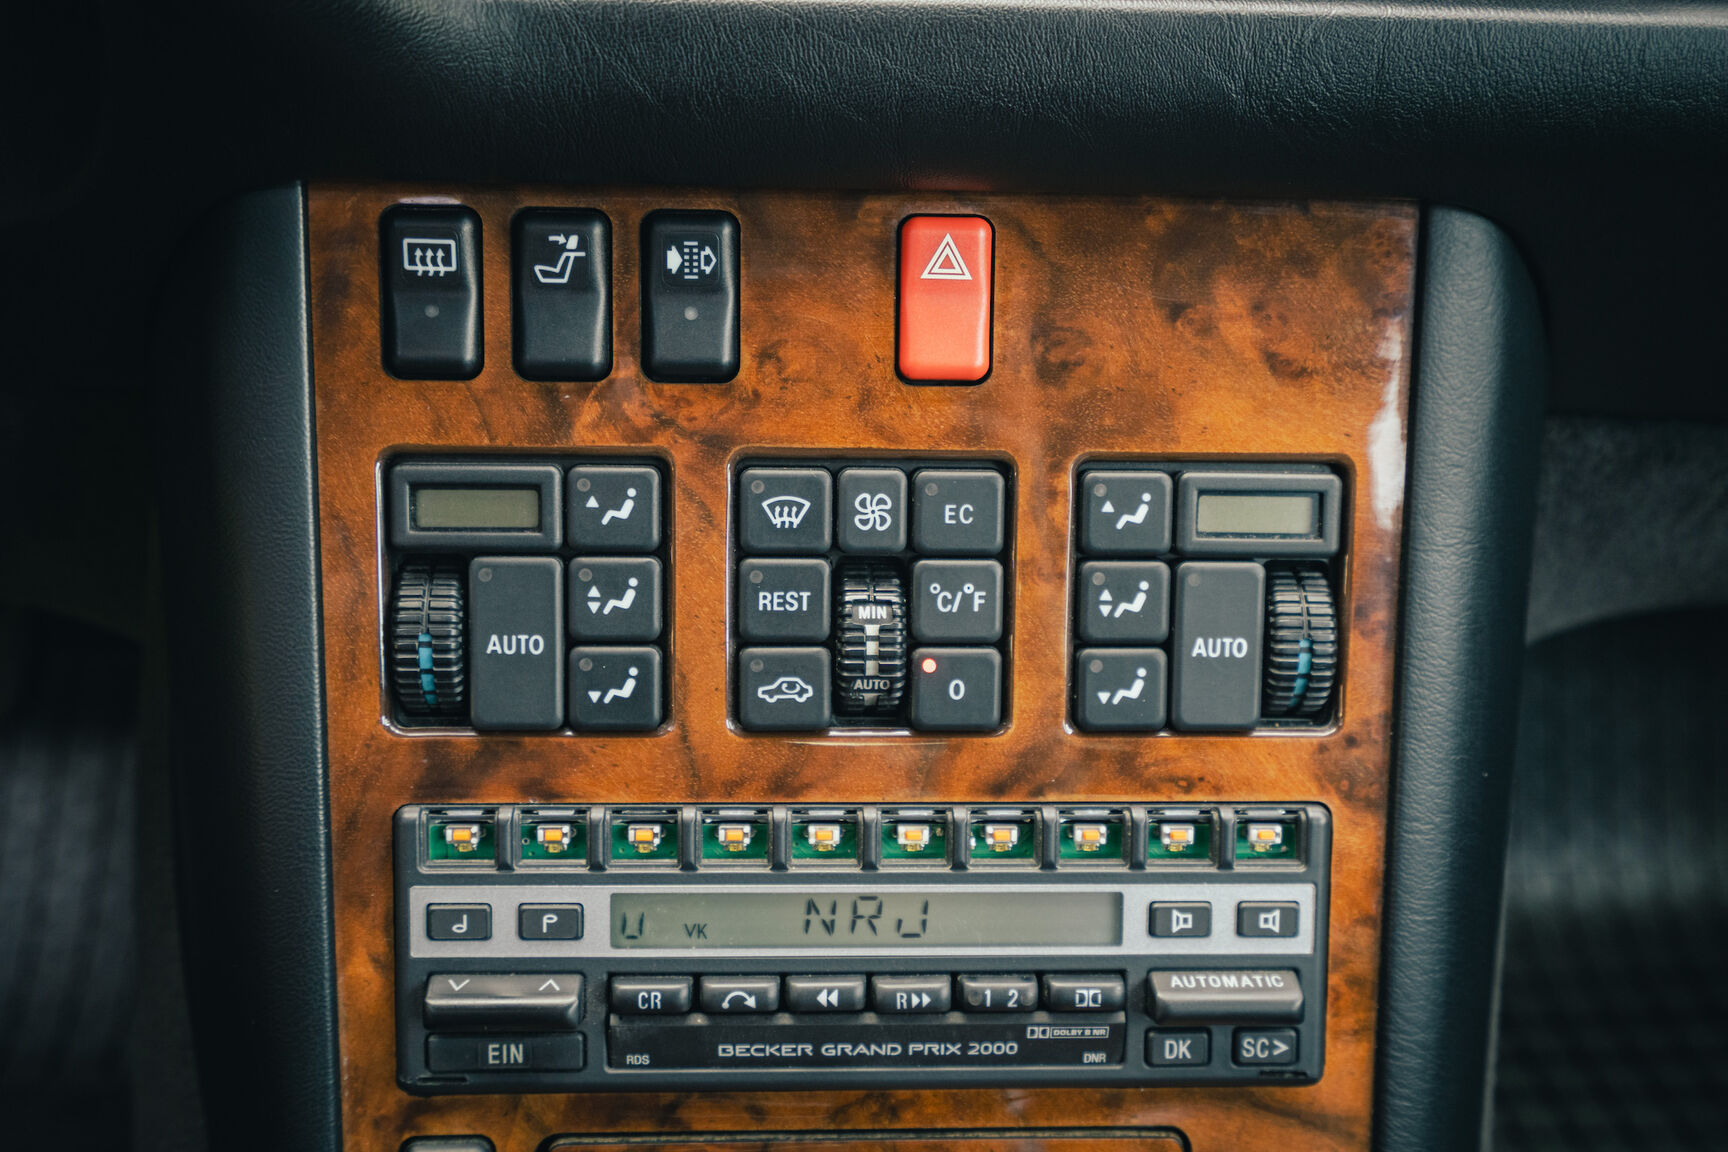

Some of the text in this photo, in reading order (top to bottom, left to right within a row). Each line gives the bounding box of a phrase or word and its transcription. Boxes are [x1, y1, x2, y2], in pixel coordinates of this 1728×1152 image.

[944, 504, 974, 525] EC
[758, 591, 812, 611] REST
[858, 605, 887, 619] MIN
[486, 634, 544, 655] AUTO
[1191, 637, 1248, 658] AUTO
[853, 679, 891, 690] AUTO
[684, 923, 707, 939] VK
[804, 895, 928, 938] NRJ
[1170, 974, 1284, 989] AUTOMATIC
[638, 991, 662, 1010] CR
[985, 989, 1019, 1008] 1 2
[487, 1043, 524, 1064] EIN
[718, 1043, 1018, 1056] BECKER GRAND PRIX 2000
[1083, 1053, 1106, 1064] DNR
[1164, 1039, 1192, 1059] DK
[626, 1054, 650, 1065] RDS
